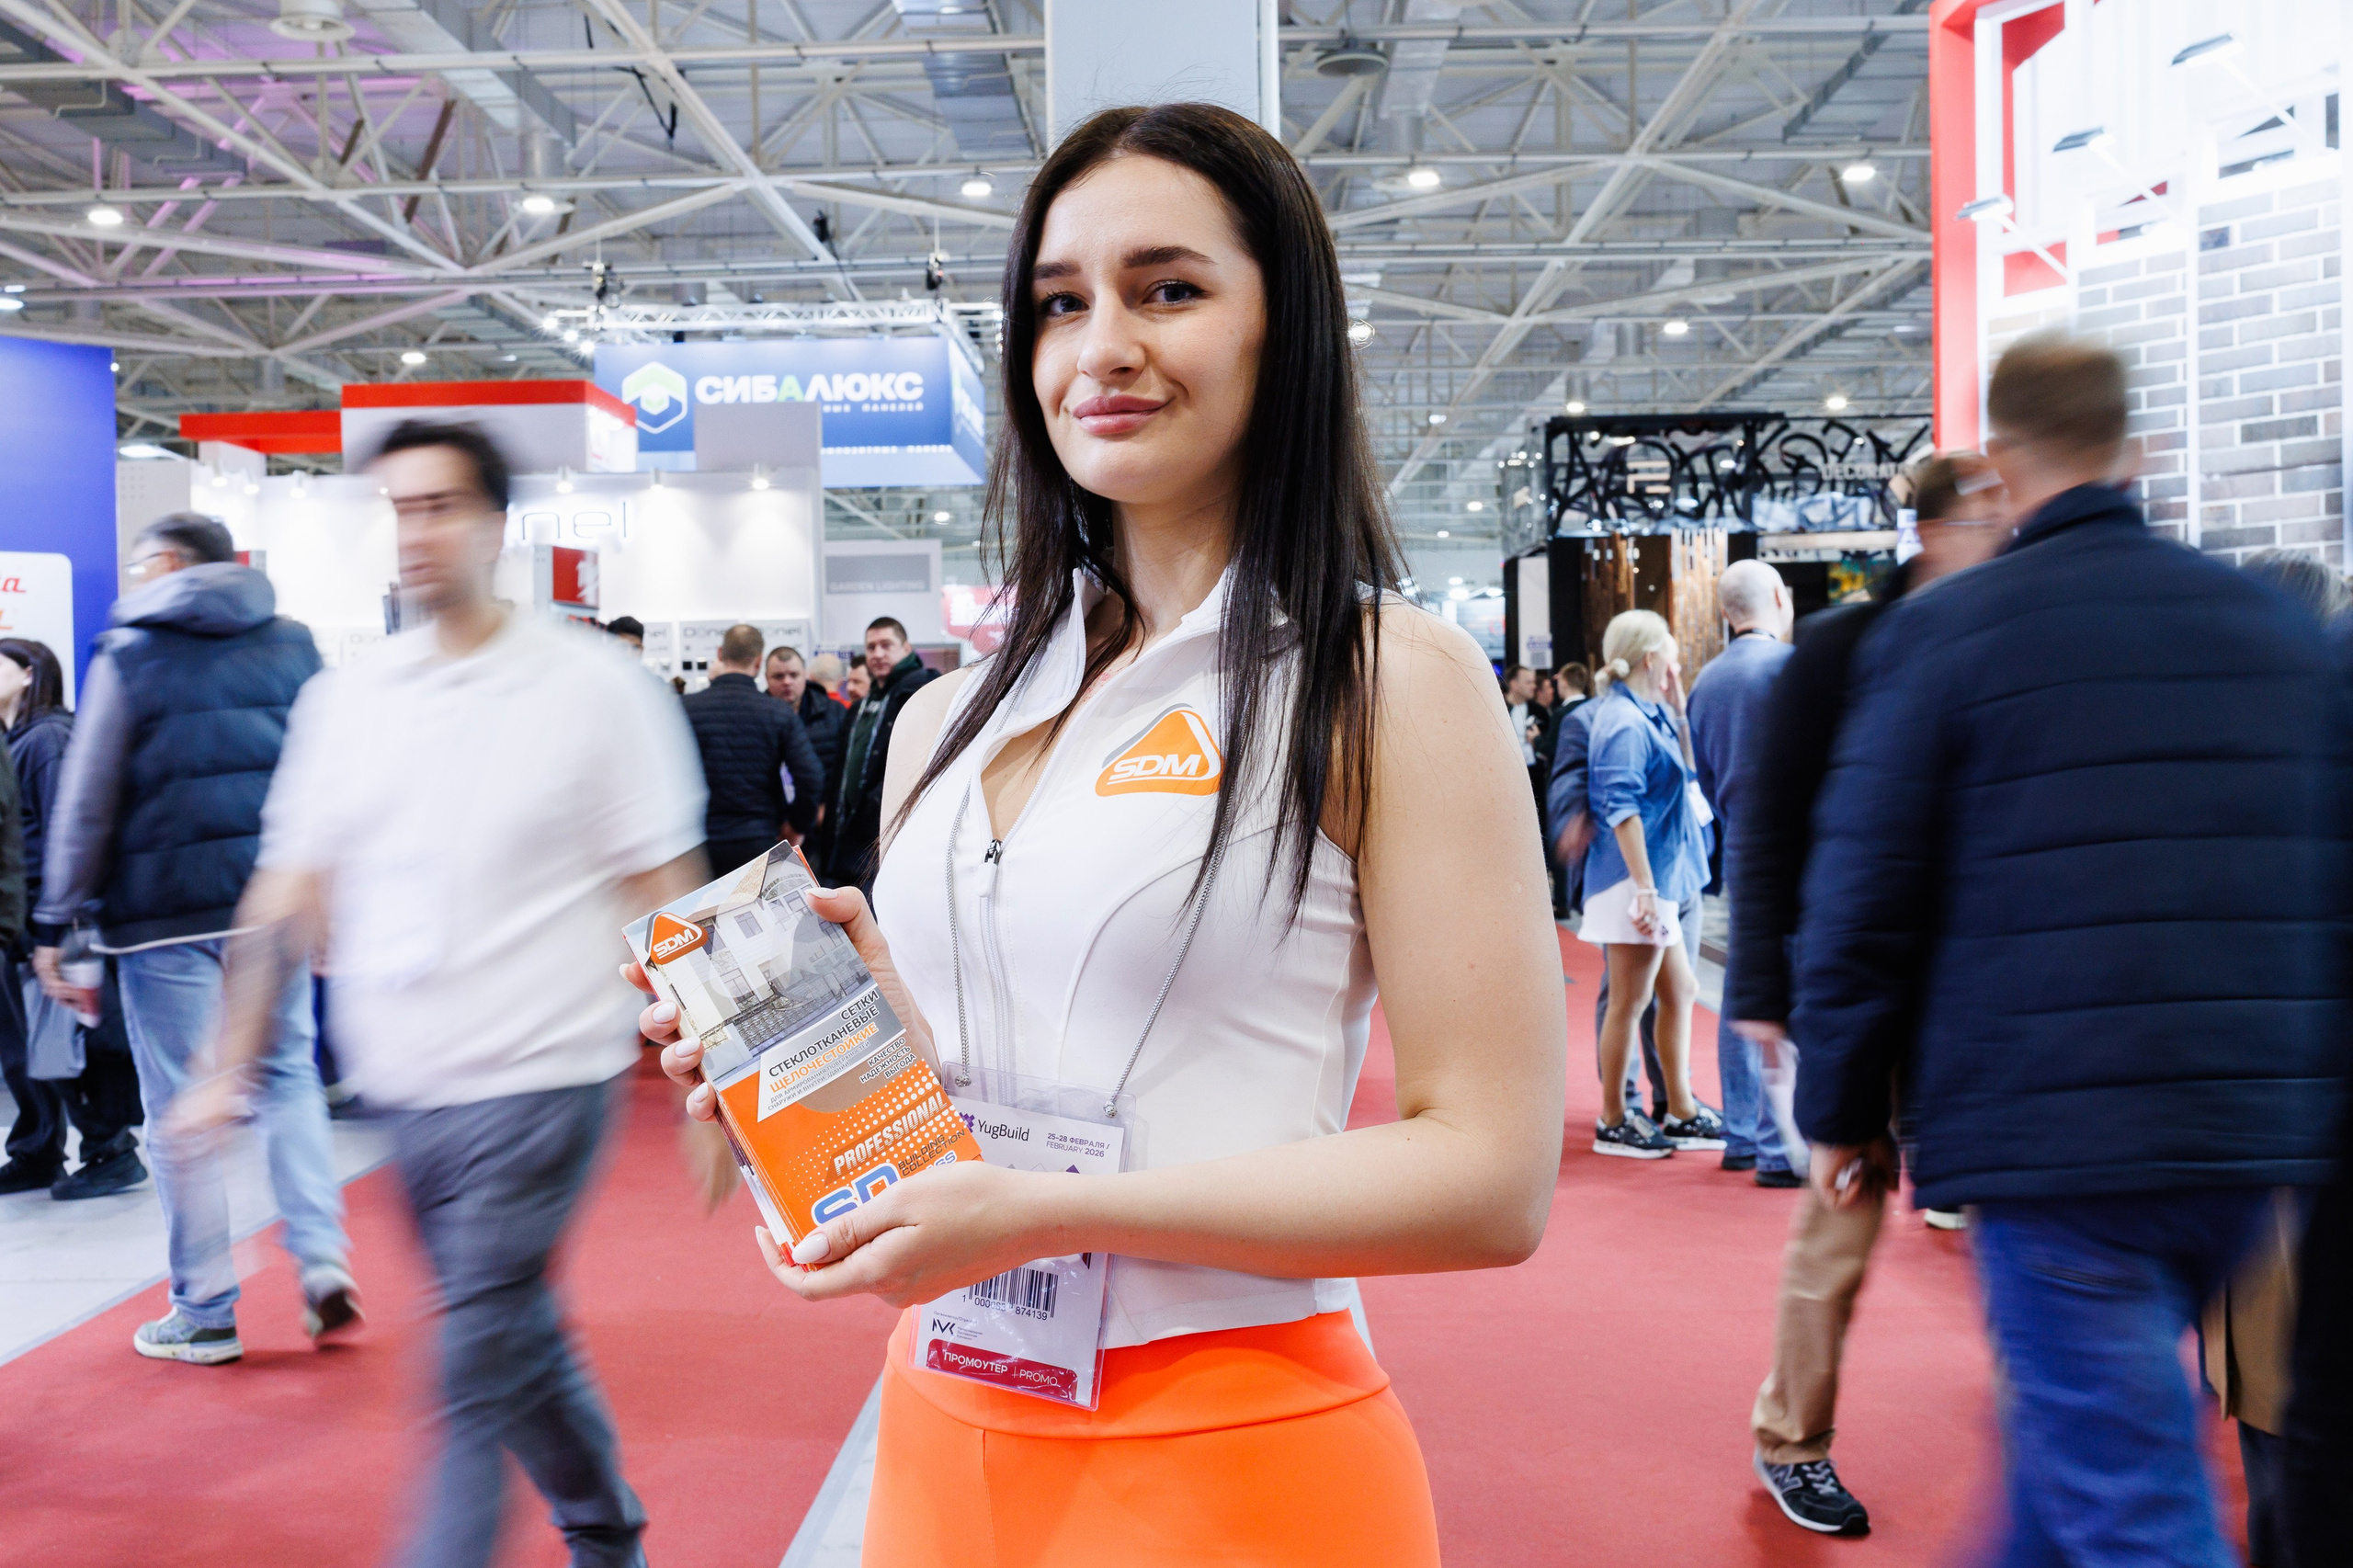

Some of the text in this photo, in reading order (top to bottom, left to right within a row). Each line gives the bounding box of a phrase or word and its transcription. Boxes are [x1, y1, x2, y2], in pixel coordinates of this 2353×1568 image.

[695, 371, 925, 404] СИБАЛЮКС
[1108, 754, 1202, 781] SDM
[653, 928, 695, 957] SDM
[841, 991, 880, 1020] СЕТКИ
[768, 1006, 880, 1077] СТЕКЛОТКАНЕВЫЕ
[769, 1023, 880, 1093] ЩЕЛОЧЕСТОЙКИЕ
[868, 1037, 906, 1067] КАЧЕСТВО
[770, 1041, 870, 1104] ДЛЯ АРМИРОВАНИЯ ПОВЕРХНОСТЕЙ
[859, 1046, 911, 1084] НАДЕЖНОСТЬ
[884, 1053, 916, 1078] ВЫГОДА
[767, 1093, 798, 1111] СНАРУЖИ
[803, 1075, 826, 1092] ВНУТРИ
[834, 1090, 948, 1176] PROFESSIONAL
[978, 1119, 1030, 1142] YugBuild
[1069, 1137, 1105, 1149] ФЕВРАЛЯ
[897, 1133, 946, 1171] BUILDING
[902, 1129, 966, 1176] COLLECTION
[1046, 1141, 1105, 1158] FEBRUARY 2026
[961, 1294, 966, 1302] 1
[1015, 1306, 1048, 1321] 874139
[943, 1351, 1058, 1386] ПРОМОУТЕР PROMO
